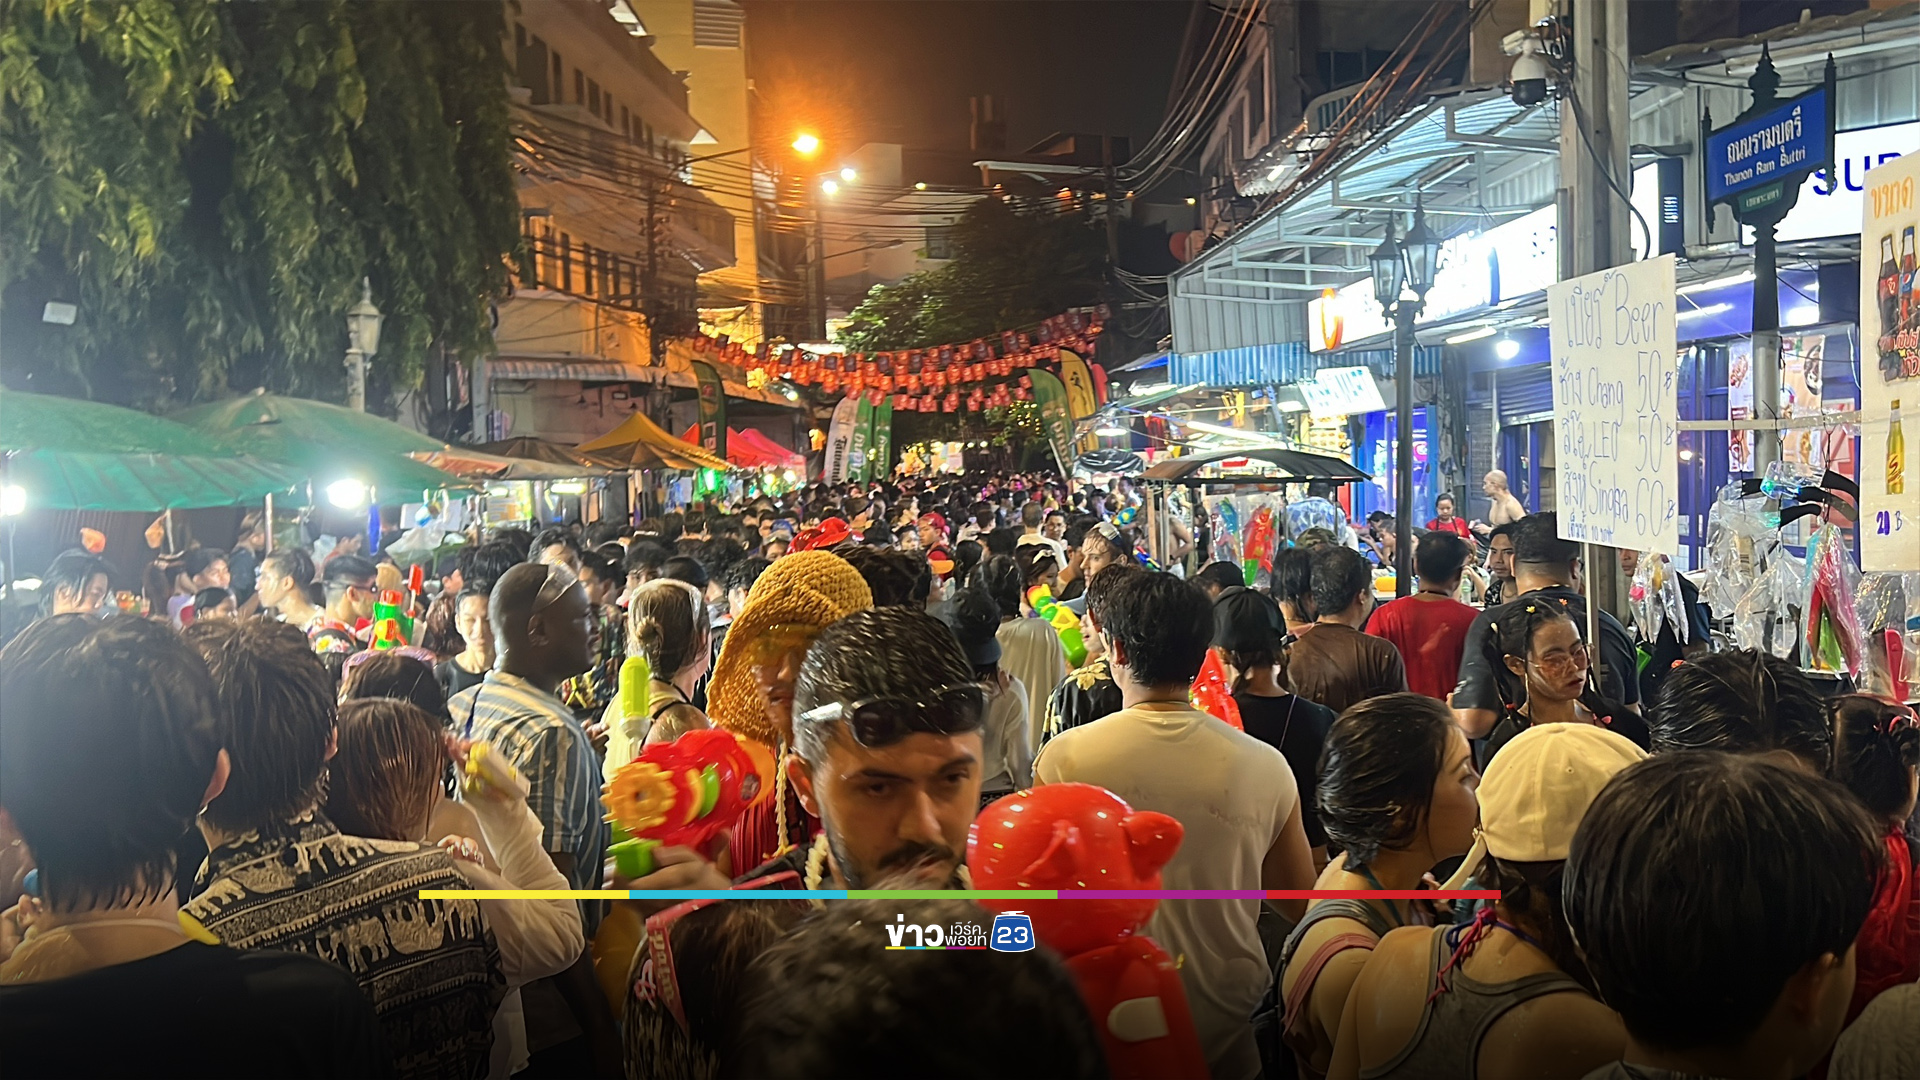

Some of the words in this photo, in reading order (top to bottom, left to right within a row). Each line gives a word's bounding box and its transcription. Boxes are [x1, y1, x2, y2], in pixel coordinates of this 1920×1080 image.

[1726, 105, 1802, 165] ถนนรามบุตรี
[1724, 168, 1753, 187] Thanon
[1756, 160, 1775, 175] Ram
[1780, 146, 1806, 167] Buttri
[1615, 273, 1664, 346] Beer
[1588, 367, 1624, 427] Chang
[1636, 350, 1662, 414] 50
[1593, 420, 1619, 462] LEO
[1635, 413, 1663, 473] 50
[1636, 478, 1664, 537] 60
